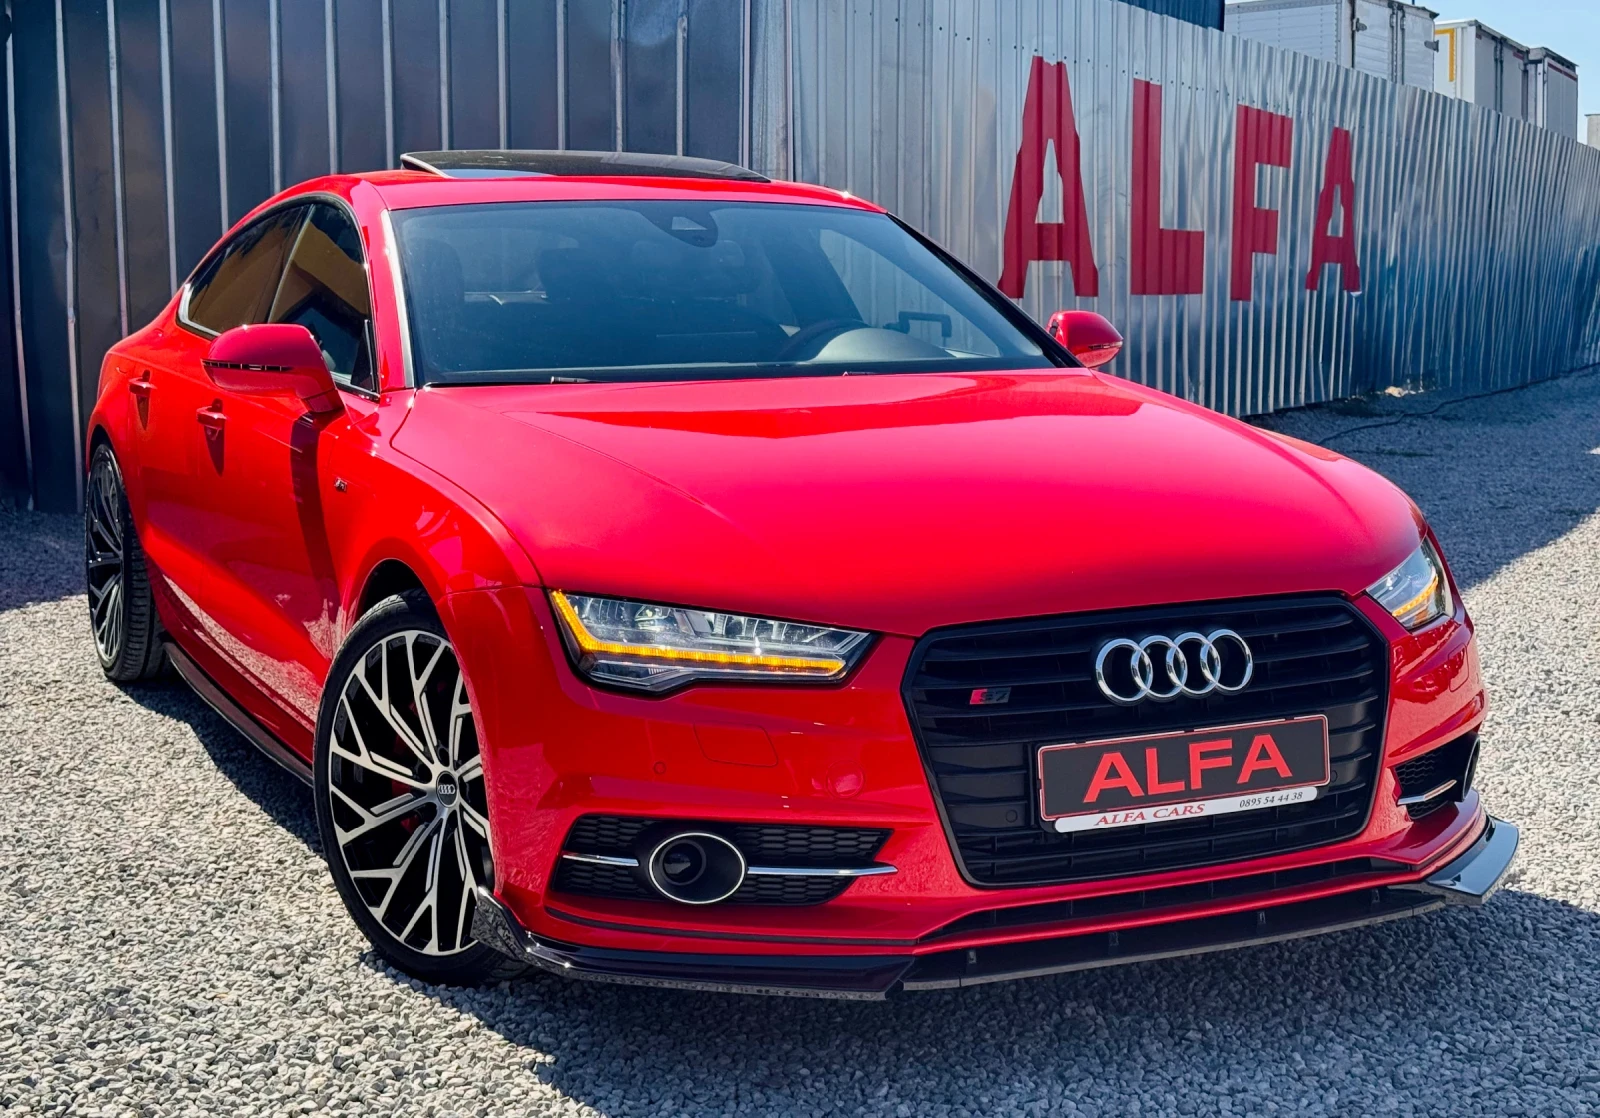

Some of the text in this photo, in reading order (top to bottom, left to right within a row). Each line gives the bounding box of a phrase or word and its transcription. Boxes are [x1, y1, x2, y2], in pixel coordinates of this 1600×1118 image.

[997, 55, 1360, 301] ALFA
[1083, 733, 1293, 803] ALFA
[1094, 791, 1303, 826] ALFA CARS 0895 54 44 38
